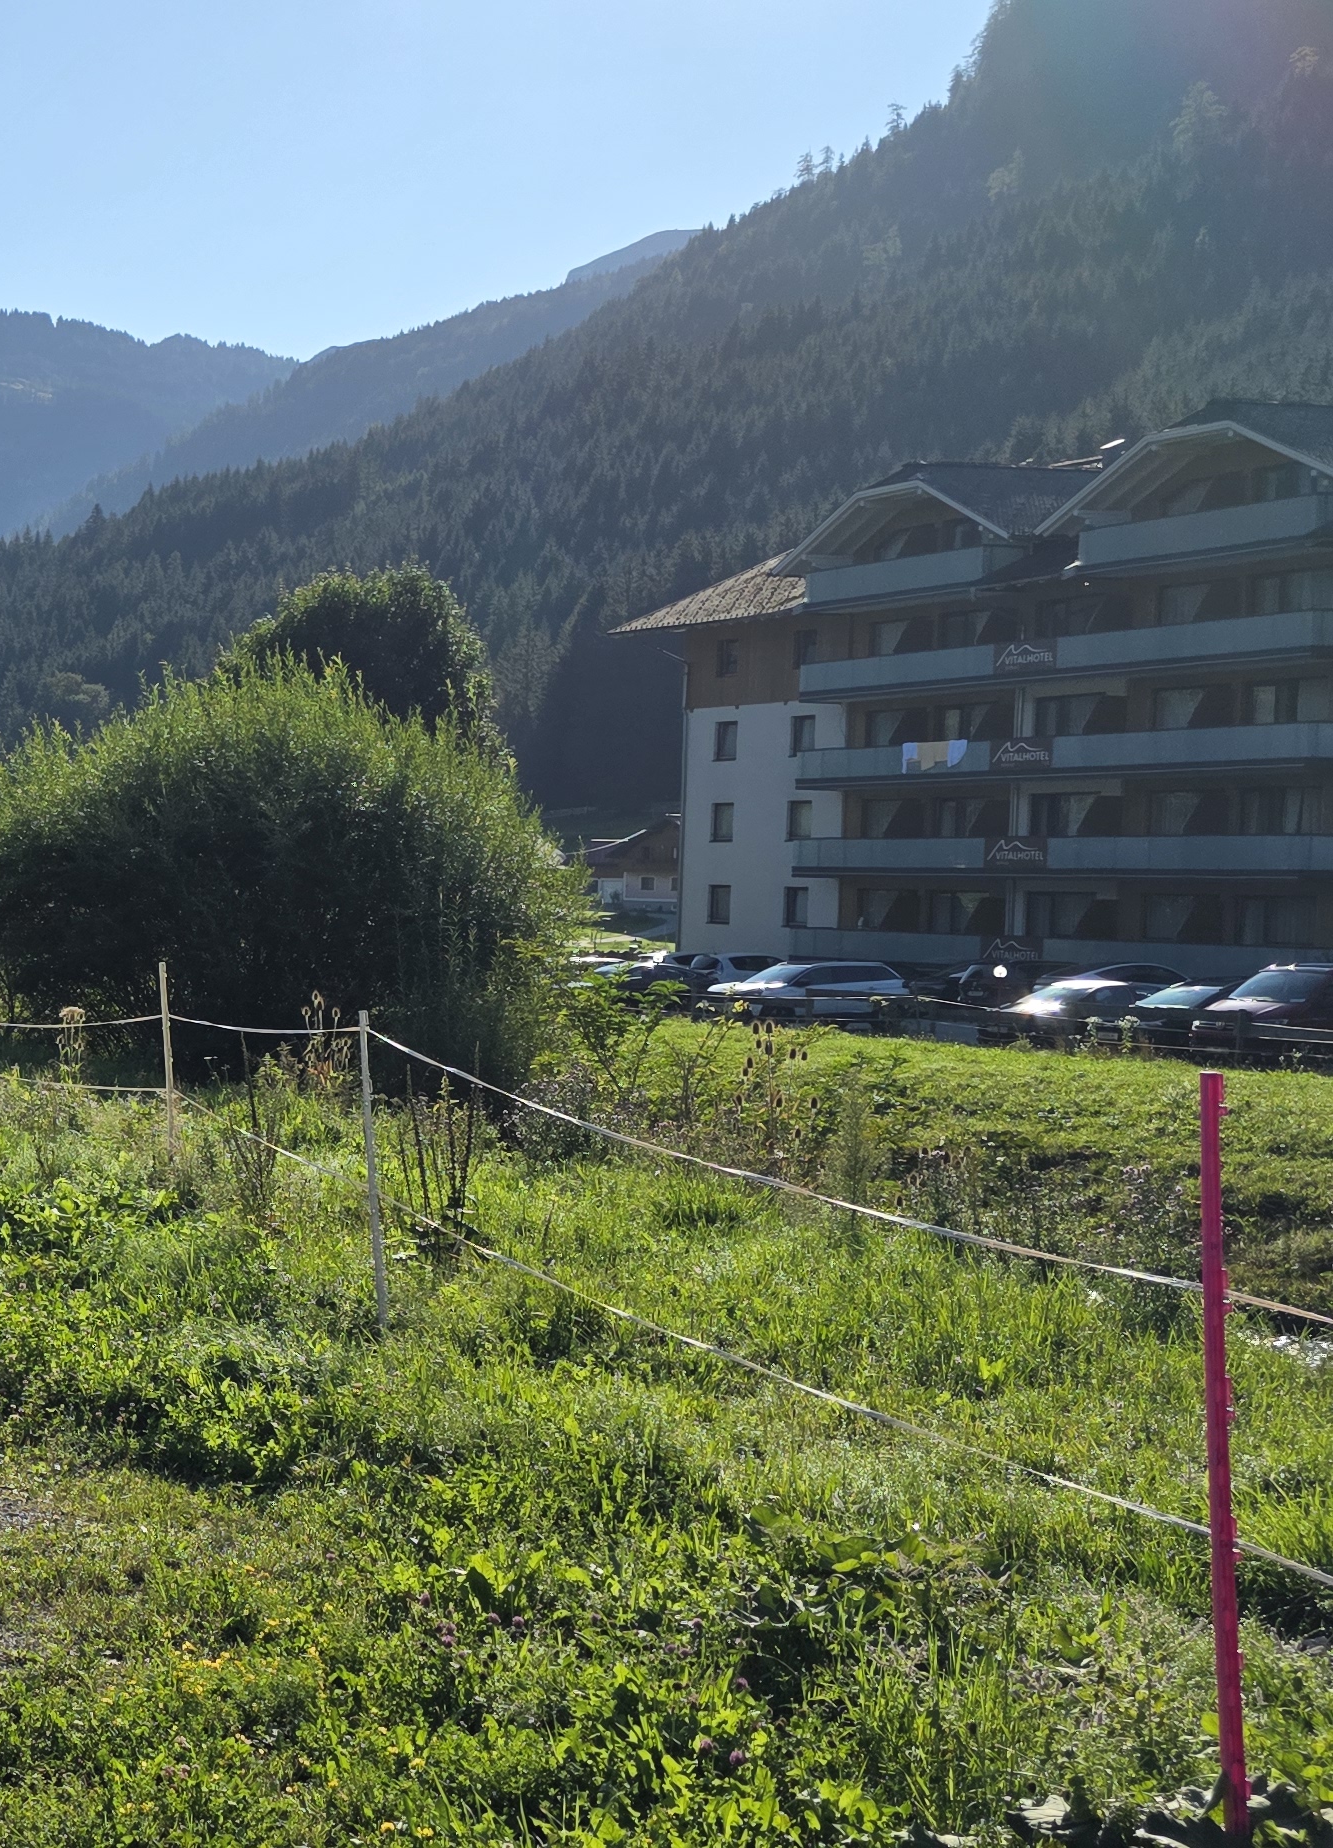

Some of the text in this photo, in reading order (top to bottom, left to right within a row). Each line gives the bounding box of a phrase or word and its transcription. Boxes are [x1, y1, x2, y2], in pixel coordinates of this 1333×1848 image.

[1004, 652, 1054, 665] VITALHOTEL
[1000, 751, 1050, 762] VITALHOTEL
[995, 851, 1044, 860] VITALHOTEL
